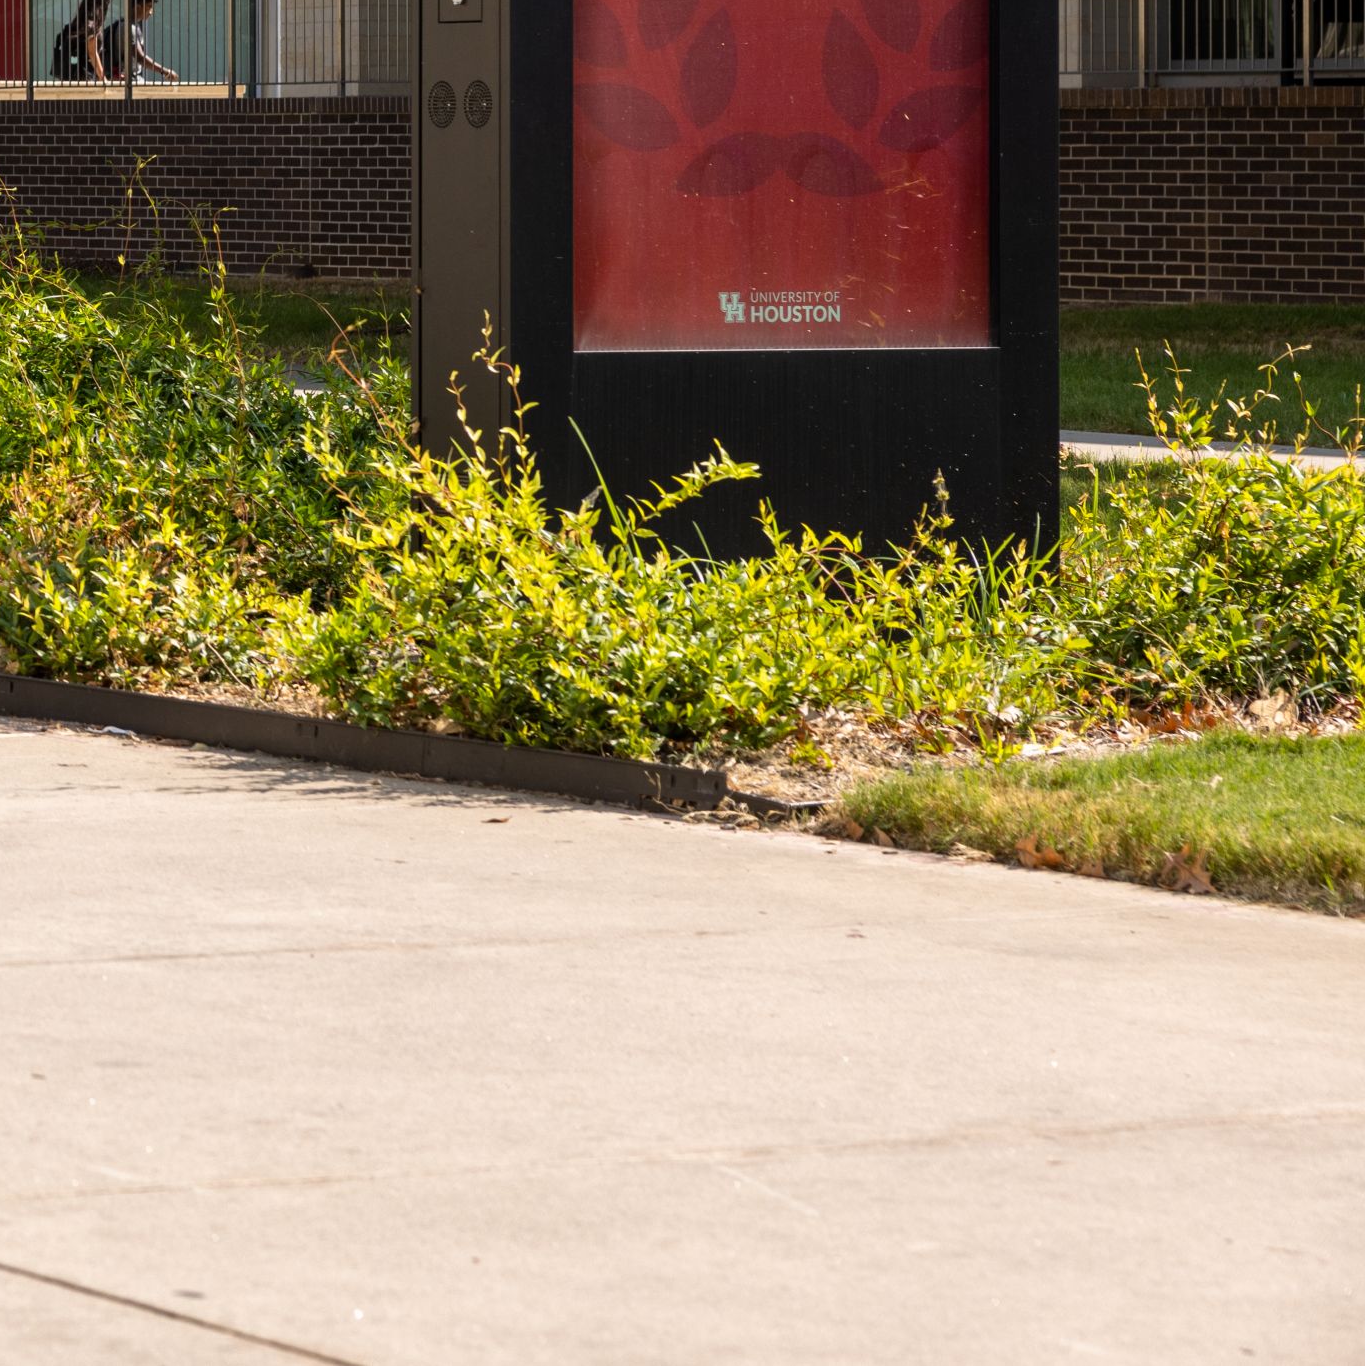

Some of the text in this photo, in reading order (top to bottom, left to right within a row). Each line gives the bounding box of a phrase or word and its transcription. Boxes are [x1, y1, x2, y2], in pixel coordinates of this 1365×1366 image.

[750, 291, 841, 303] UNIVERSITY OF
[751, 305, 841, 323] HOUSTON
